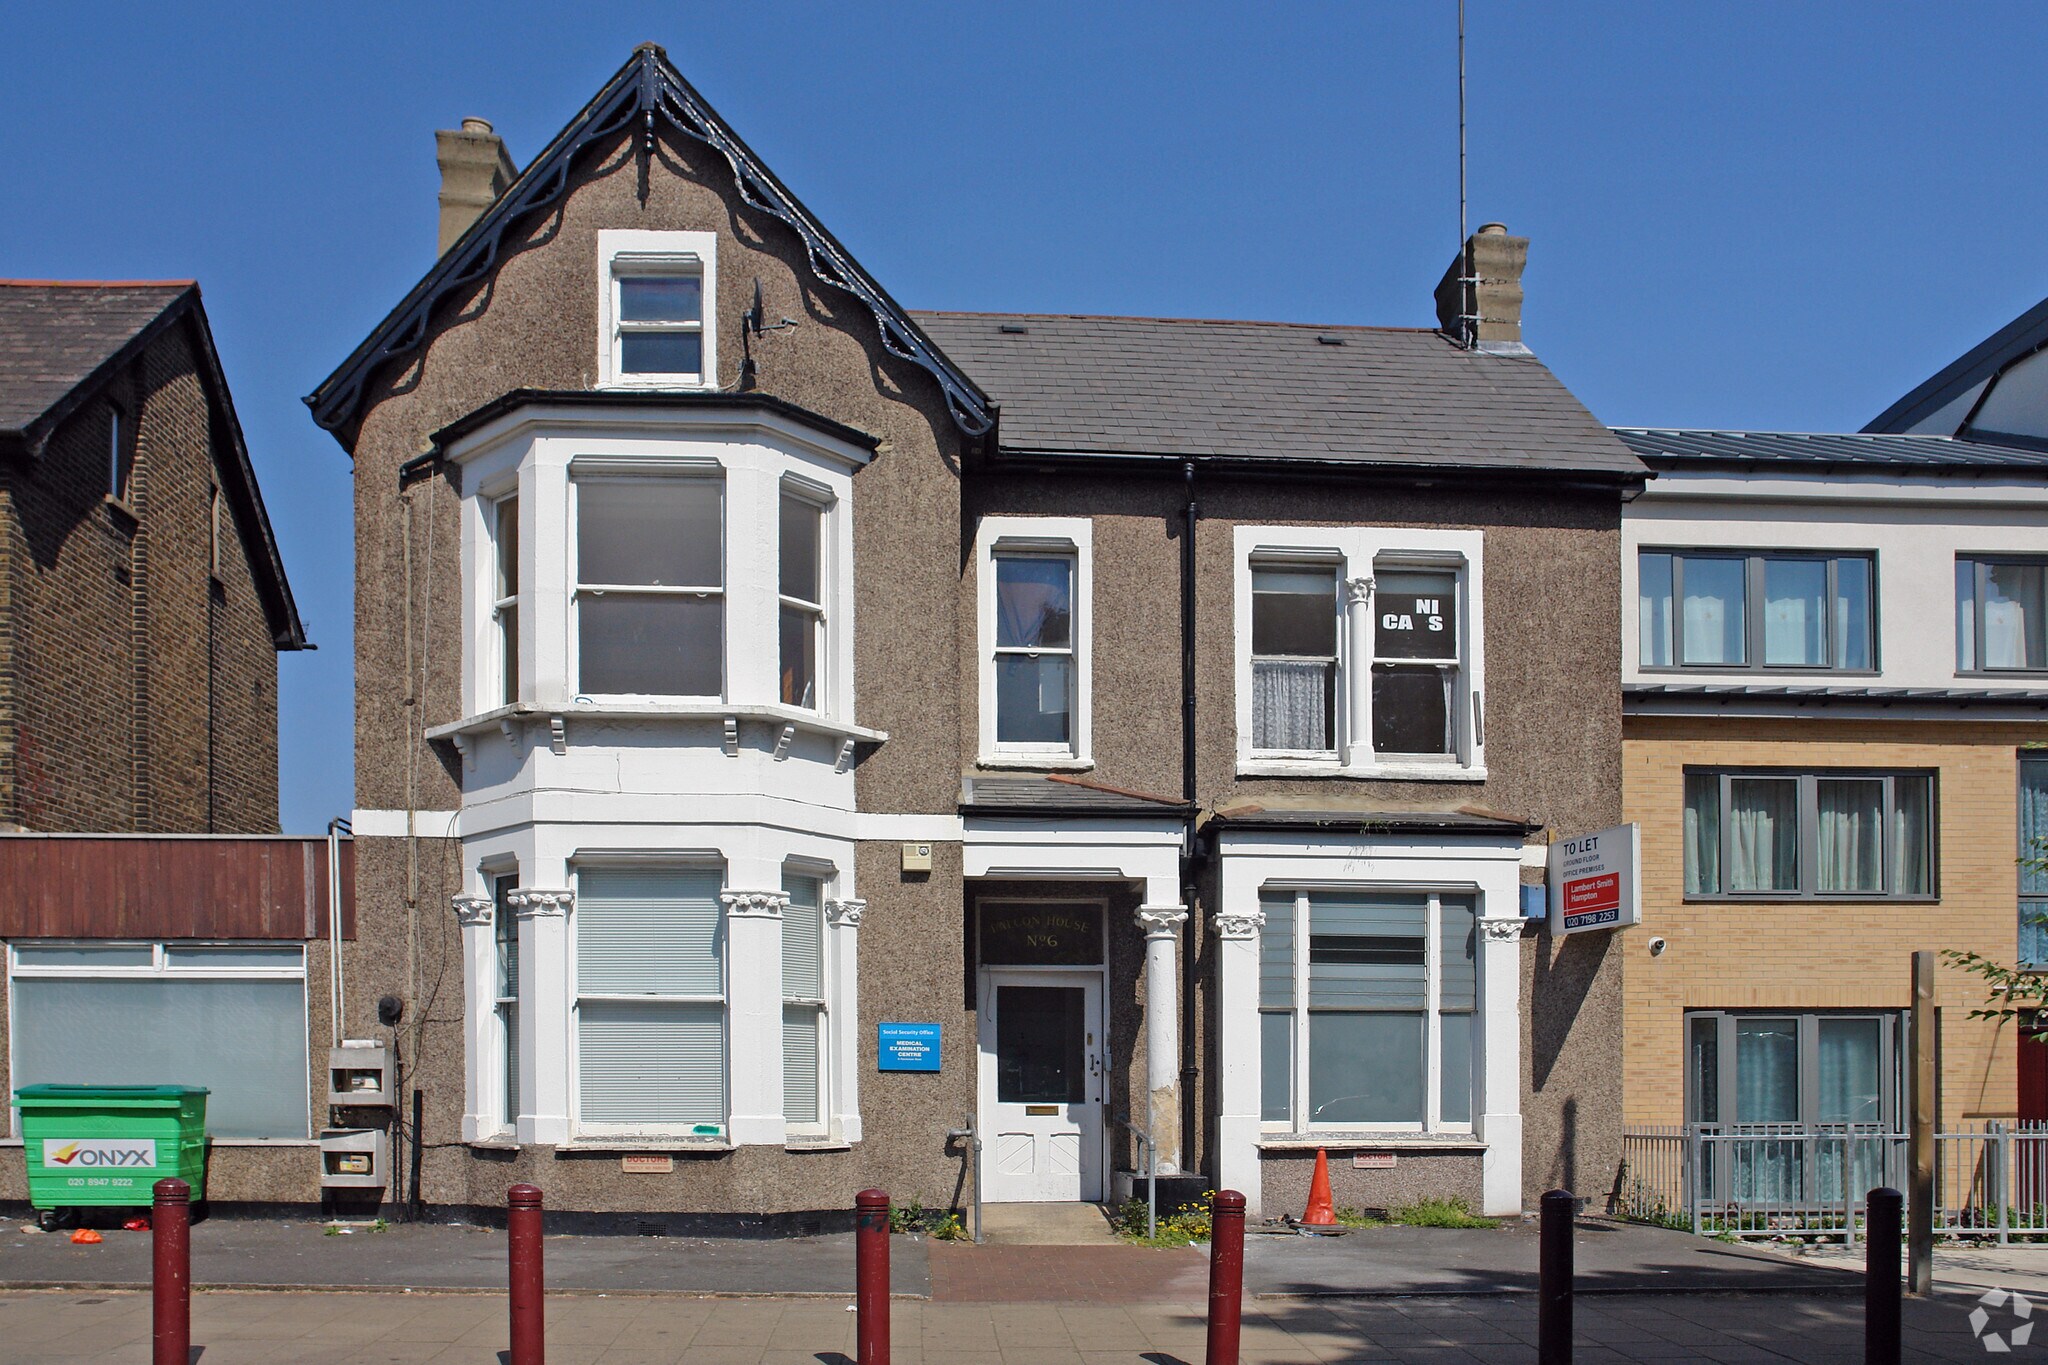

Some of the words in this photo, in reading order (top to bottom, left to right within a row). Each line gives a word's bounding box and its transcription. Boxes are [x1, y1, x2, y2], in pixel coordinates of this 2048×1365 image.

[1416, 599, 1439, 614] NI
[1564, 842, 1576, 856] TO
[1579, 837, 1598, 852] LET
[1563, 857, 1582, 867] GROUND
[1583, 854, 1600, 863] FLOOR
[1563, 869, 1580, 878] OFFICE
[1579, 864, 1605, 875] PREMISES
[1571, 882, 1596, 893] Lambert
[1597, 878, 1614, 889] Smith
[1571, 892, 1597, 902] Hampton
[1047, 916, 1088, 932] HOUSE
[1567, 918, 1579, 927] 020
[1599, 911, 1615, 920] 2253
[79, 1149, 151, 1166] ONYX
[626, 1155, 669, 1163] DOCTORS
[68, 1178, 84, 1186] 020
[88, 1178, 109, 1186] 8947
[112, 1178, 133, 1186] 9222
